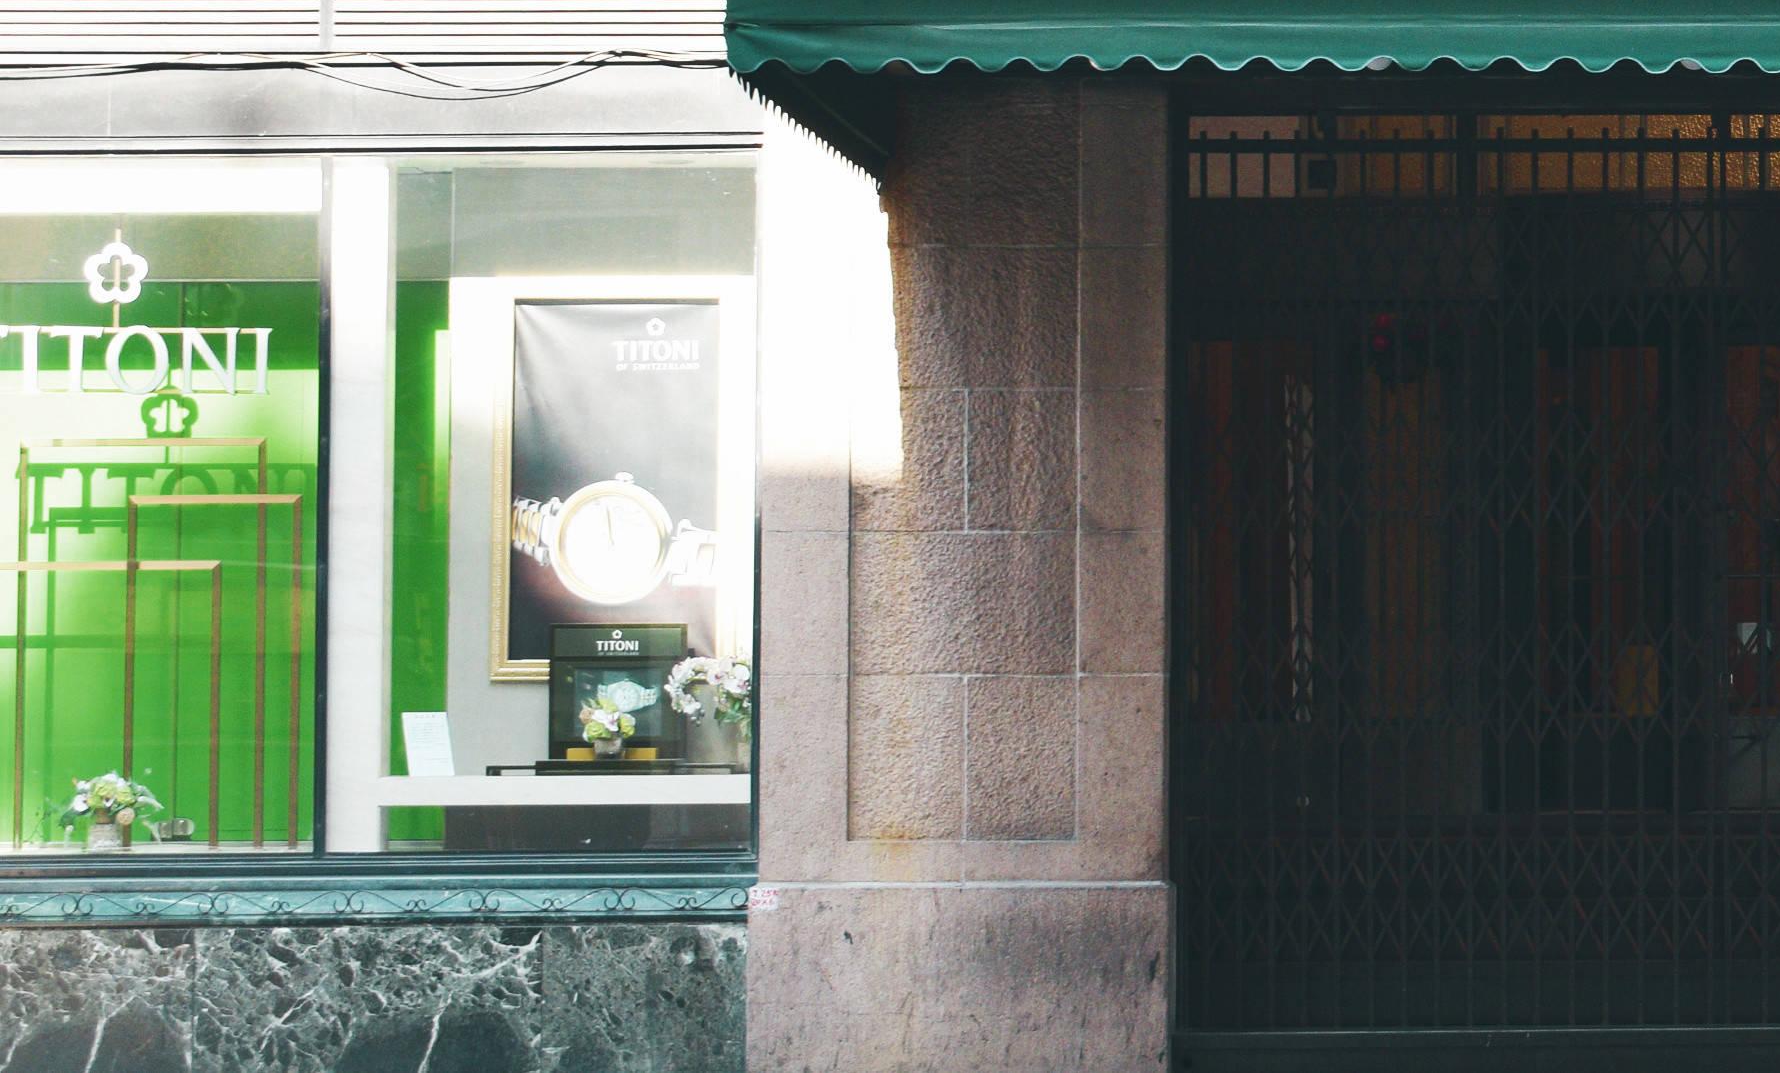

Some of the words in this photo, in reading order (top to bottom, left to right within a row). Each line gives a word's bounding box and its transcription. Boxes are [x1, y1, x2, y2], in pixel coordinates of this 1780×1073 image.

[0, 324, 273, 396] ITONI
[611, 339, 700, 362] TITONI
[595, 640, 639, 651] TITONI
